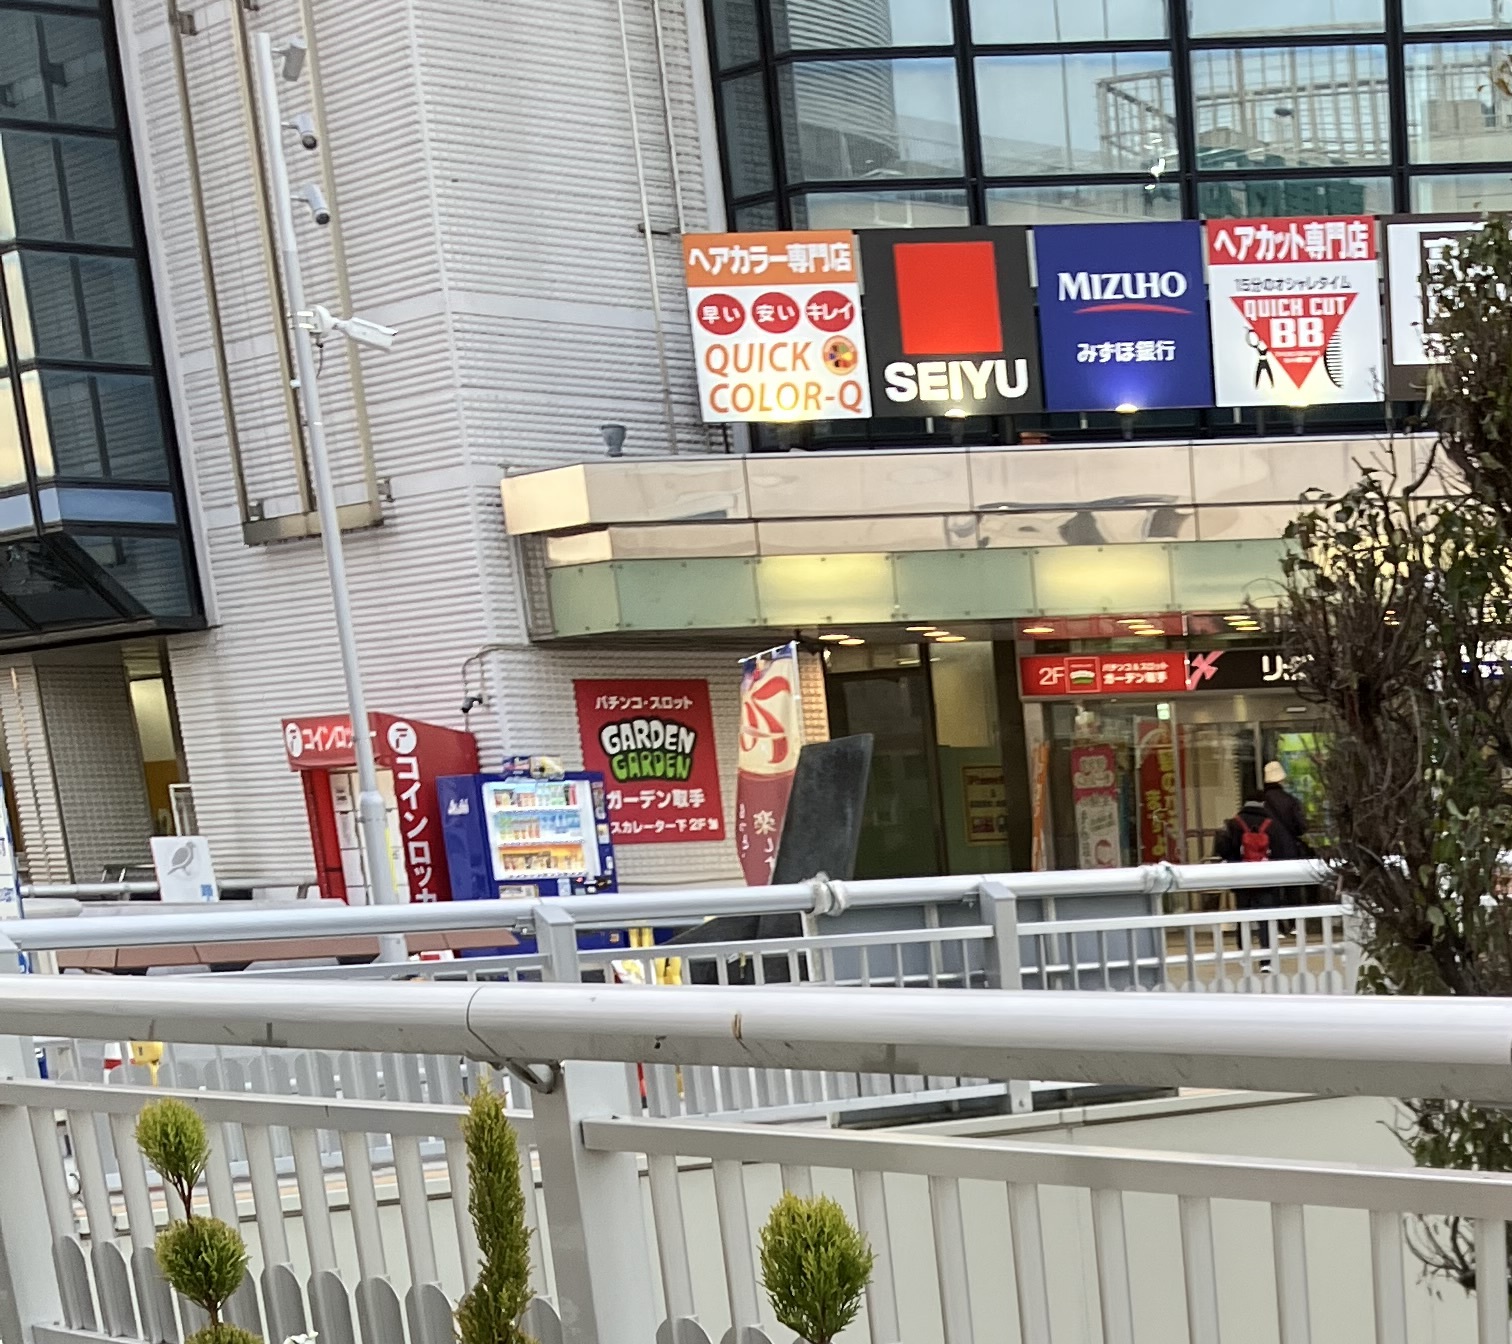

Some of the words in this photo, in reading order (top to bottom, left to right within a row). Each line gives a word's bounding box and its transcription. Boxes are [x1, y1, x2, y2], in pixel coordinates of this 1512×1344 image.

[1213, 220, 1369, 261] ヘアカット専門店
[688, 241, 852, 276] ヘアカラー専門店
[1057, 271, 1187, 301] MIZUHO
[1234, 275, 1352, 292] 15分のオシャレタイム
[702, 305, 741, 325] 早い
[756, 304, 796, 323] 安い
[806, 302, 853, 322] キレイ
[1309, 296, 1347, 316] CUT
[1269, 317, 1325, 348] BB
[704, 341, 814, 377] QUICK
[1077, 340, 1176, 363] みずほ銀行
[884, 358, 1029, 402] SEIYU
[708, 380, 864, 415] COLOR-Q
[1038, 666, 1065, 686] 2F
[600, 719, 696, 755] GARDEN
[611, 751, 691, 780] GARDEN
[606, 788, 705, 810] ガーデン取手
